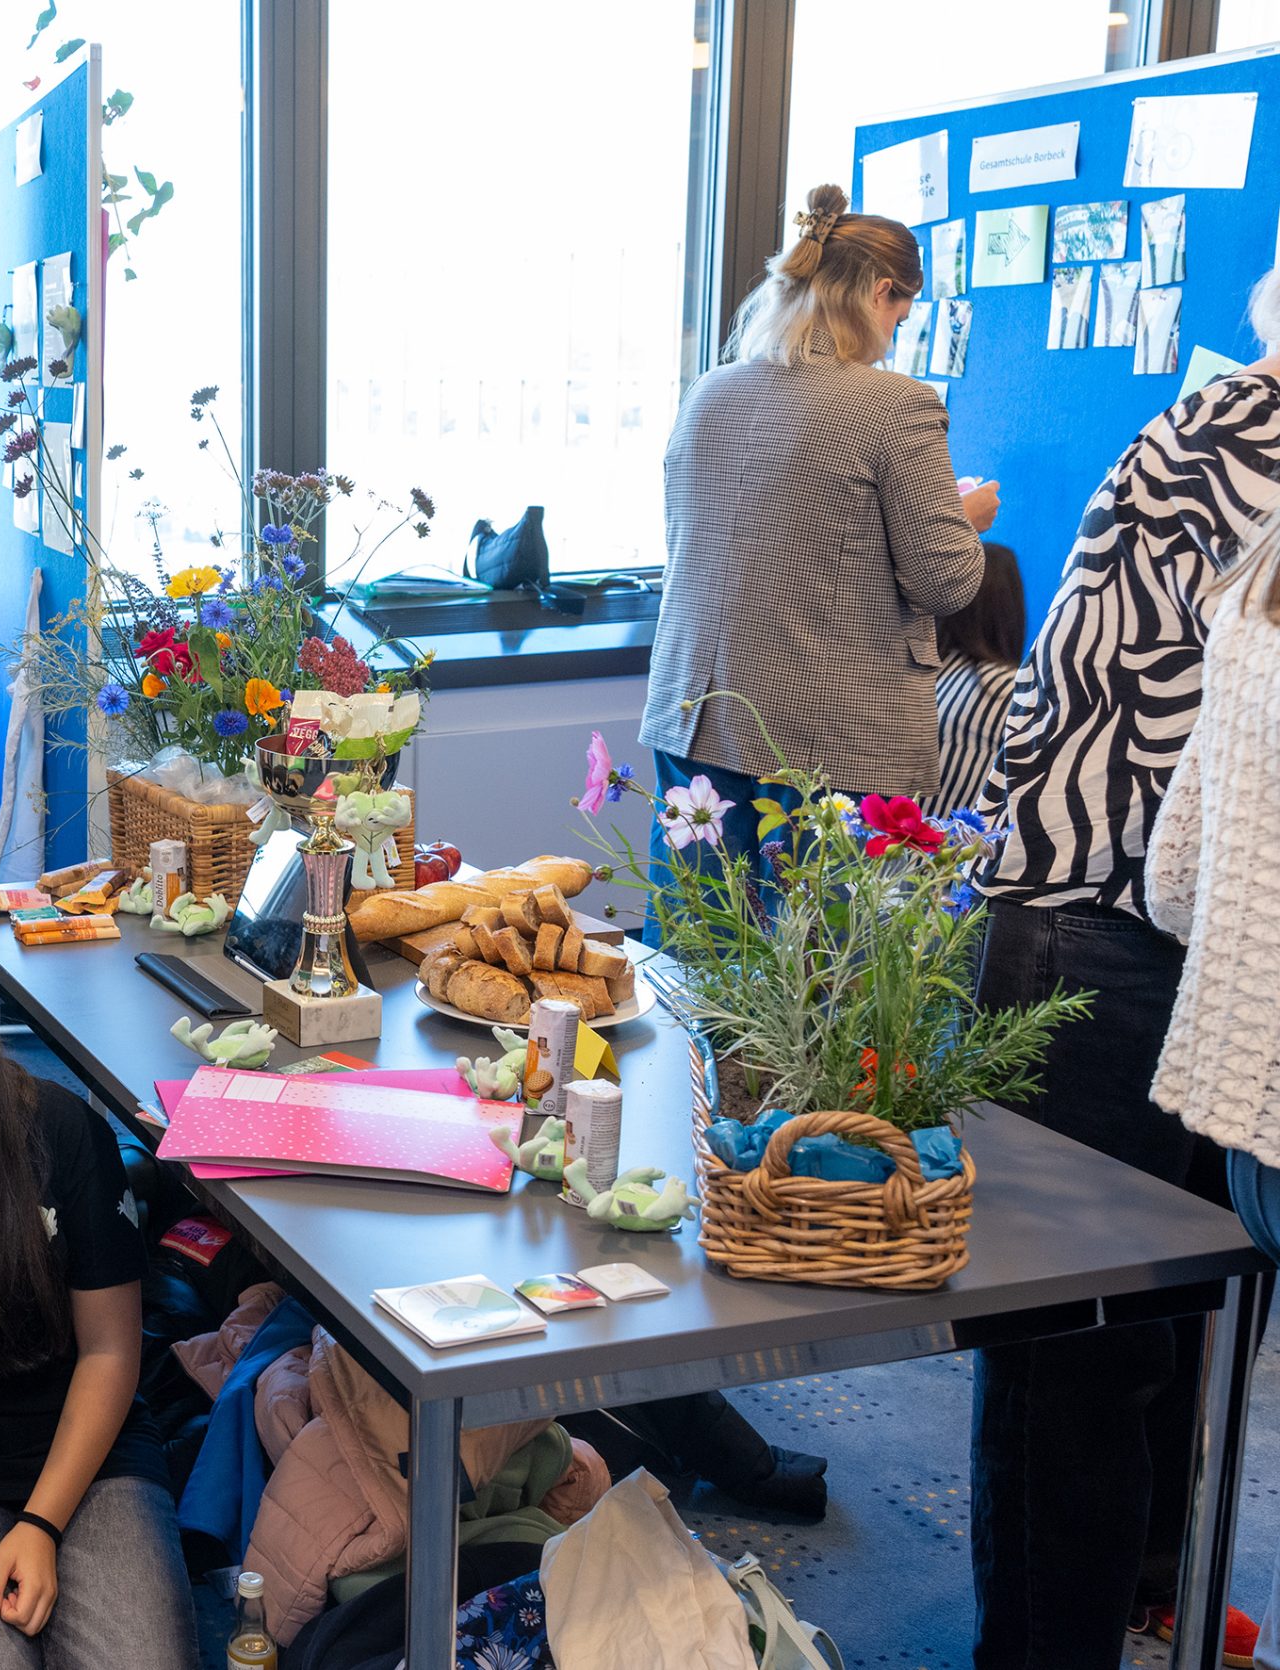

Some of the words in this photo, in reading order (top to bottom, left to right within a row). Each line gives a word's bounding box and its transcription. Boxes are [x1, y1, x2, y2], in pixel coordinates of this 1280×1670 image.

[980, 153, 1032, 170] Gesamtschule
[1033, 149, 1065, 162] Borbeck
[292, 727, 319, 741] VEGG
[156, 874, 164, 908] Doblito
